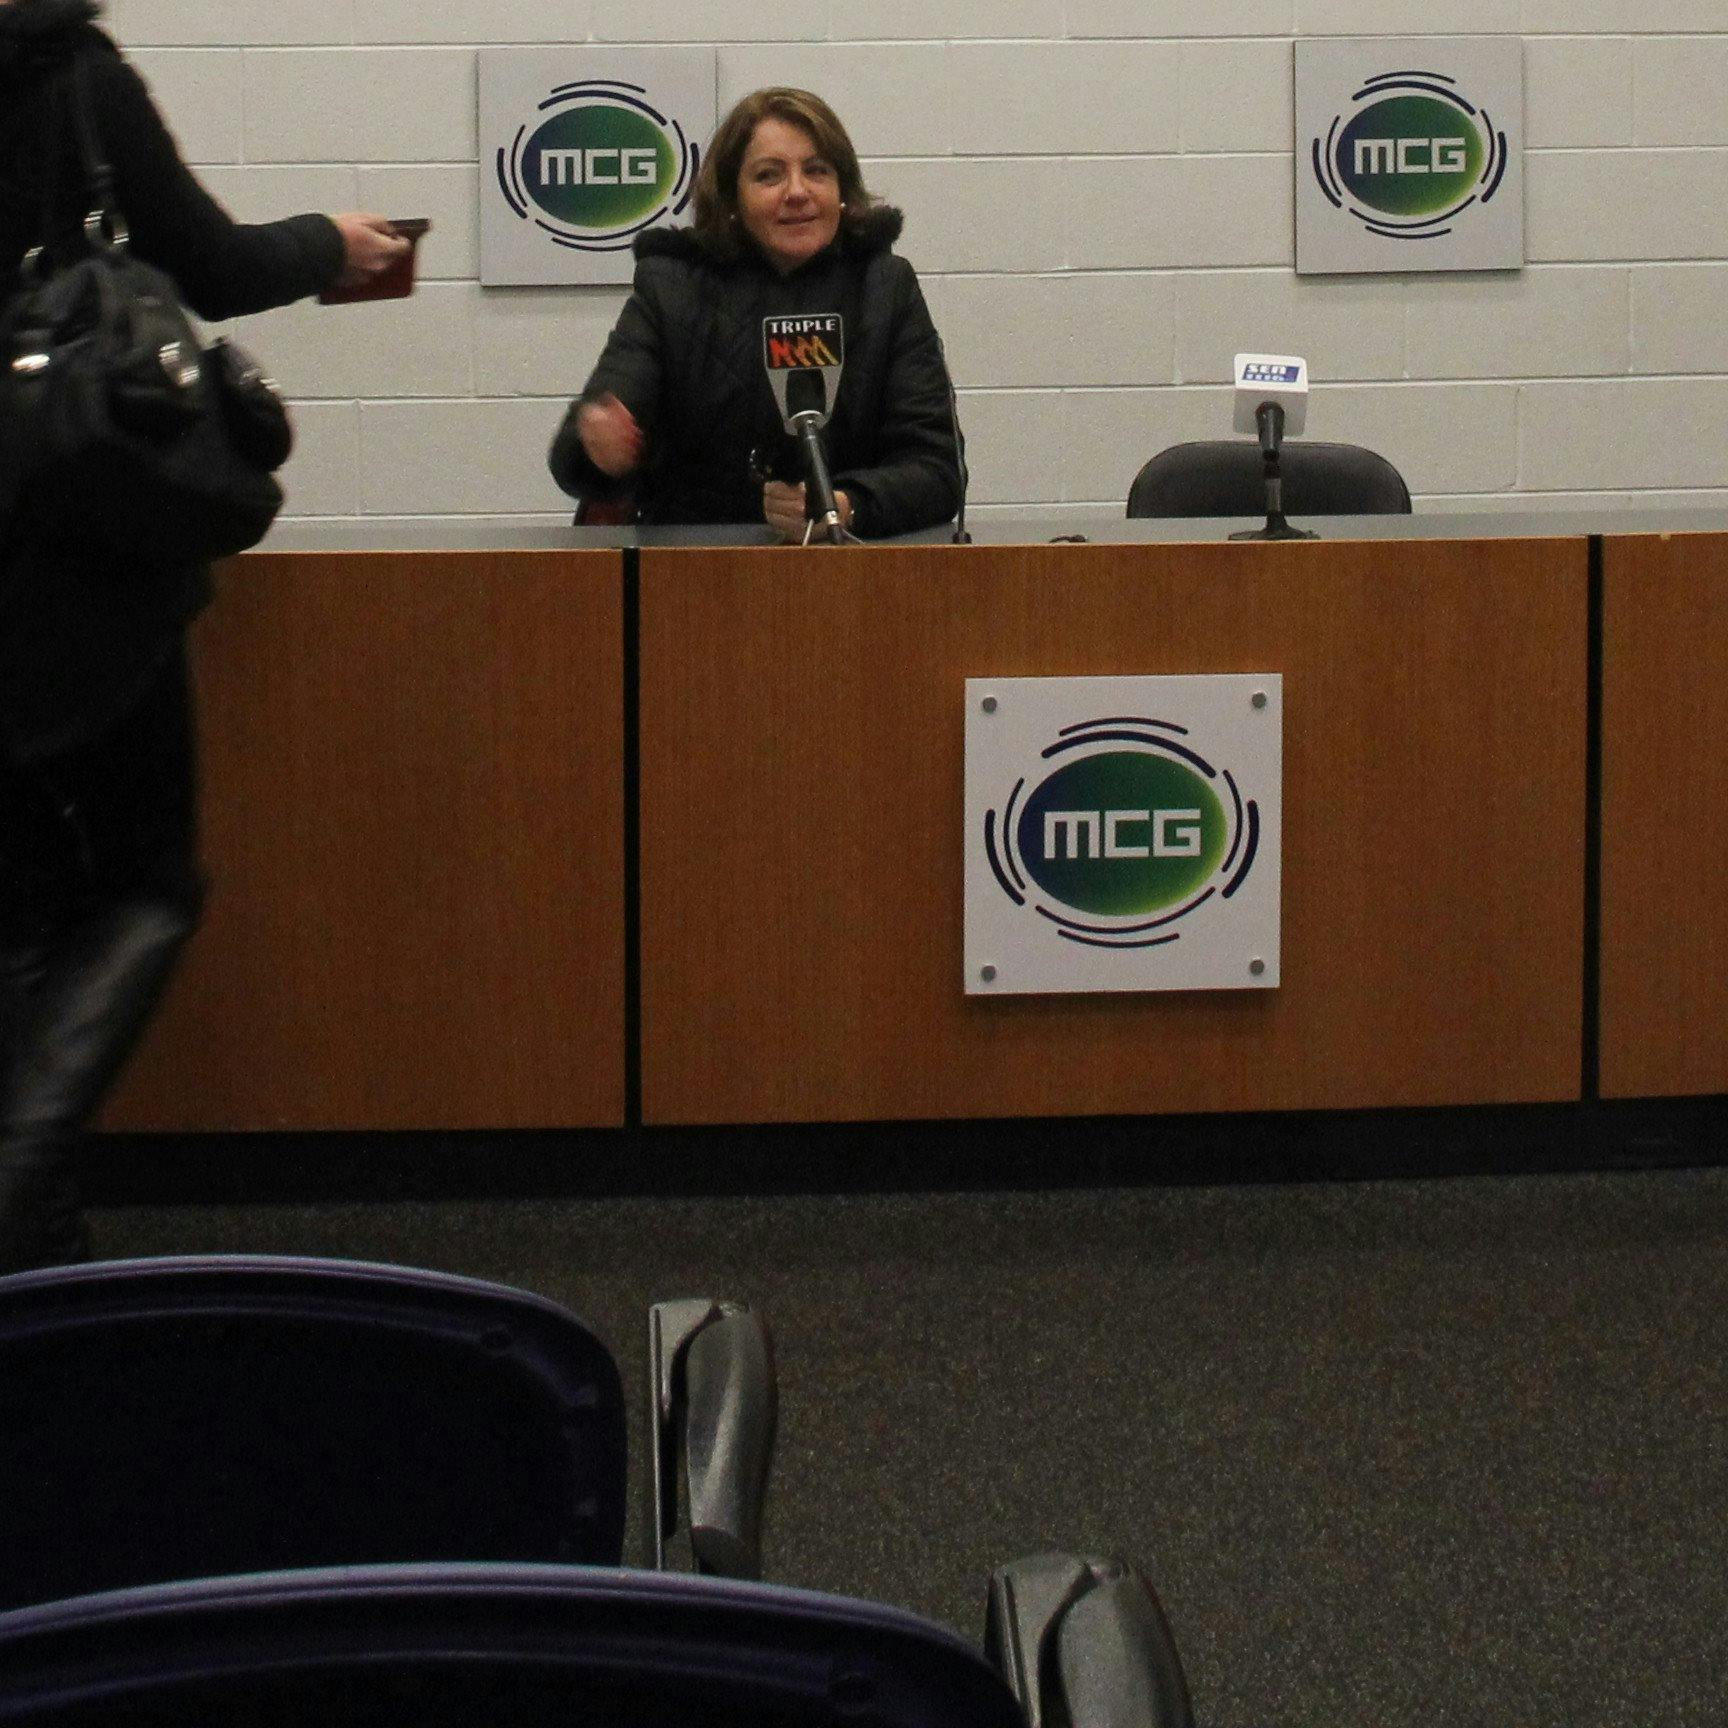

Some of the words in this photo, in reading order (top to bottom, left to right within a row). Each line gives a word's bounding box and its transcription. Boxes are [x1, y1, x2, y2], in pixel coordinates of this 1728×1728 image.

[539, 148, 657, 186] MCG
[1354, 138, 1467, 175] MCG
[769, 319, 836, 334] TRIPLE
[1044, 809, 1201, 859] MCG
